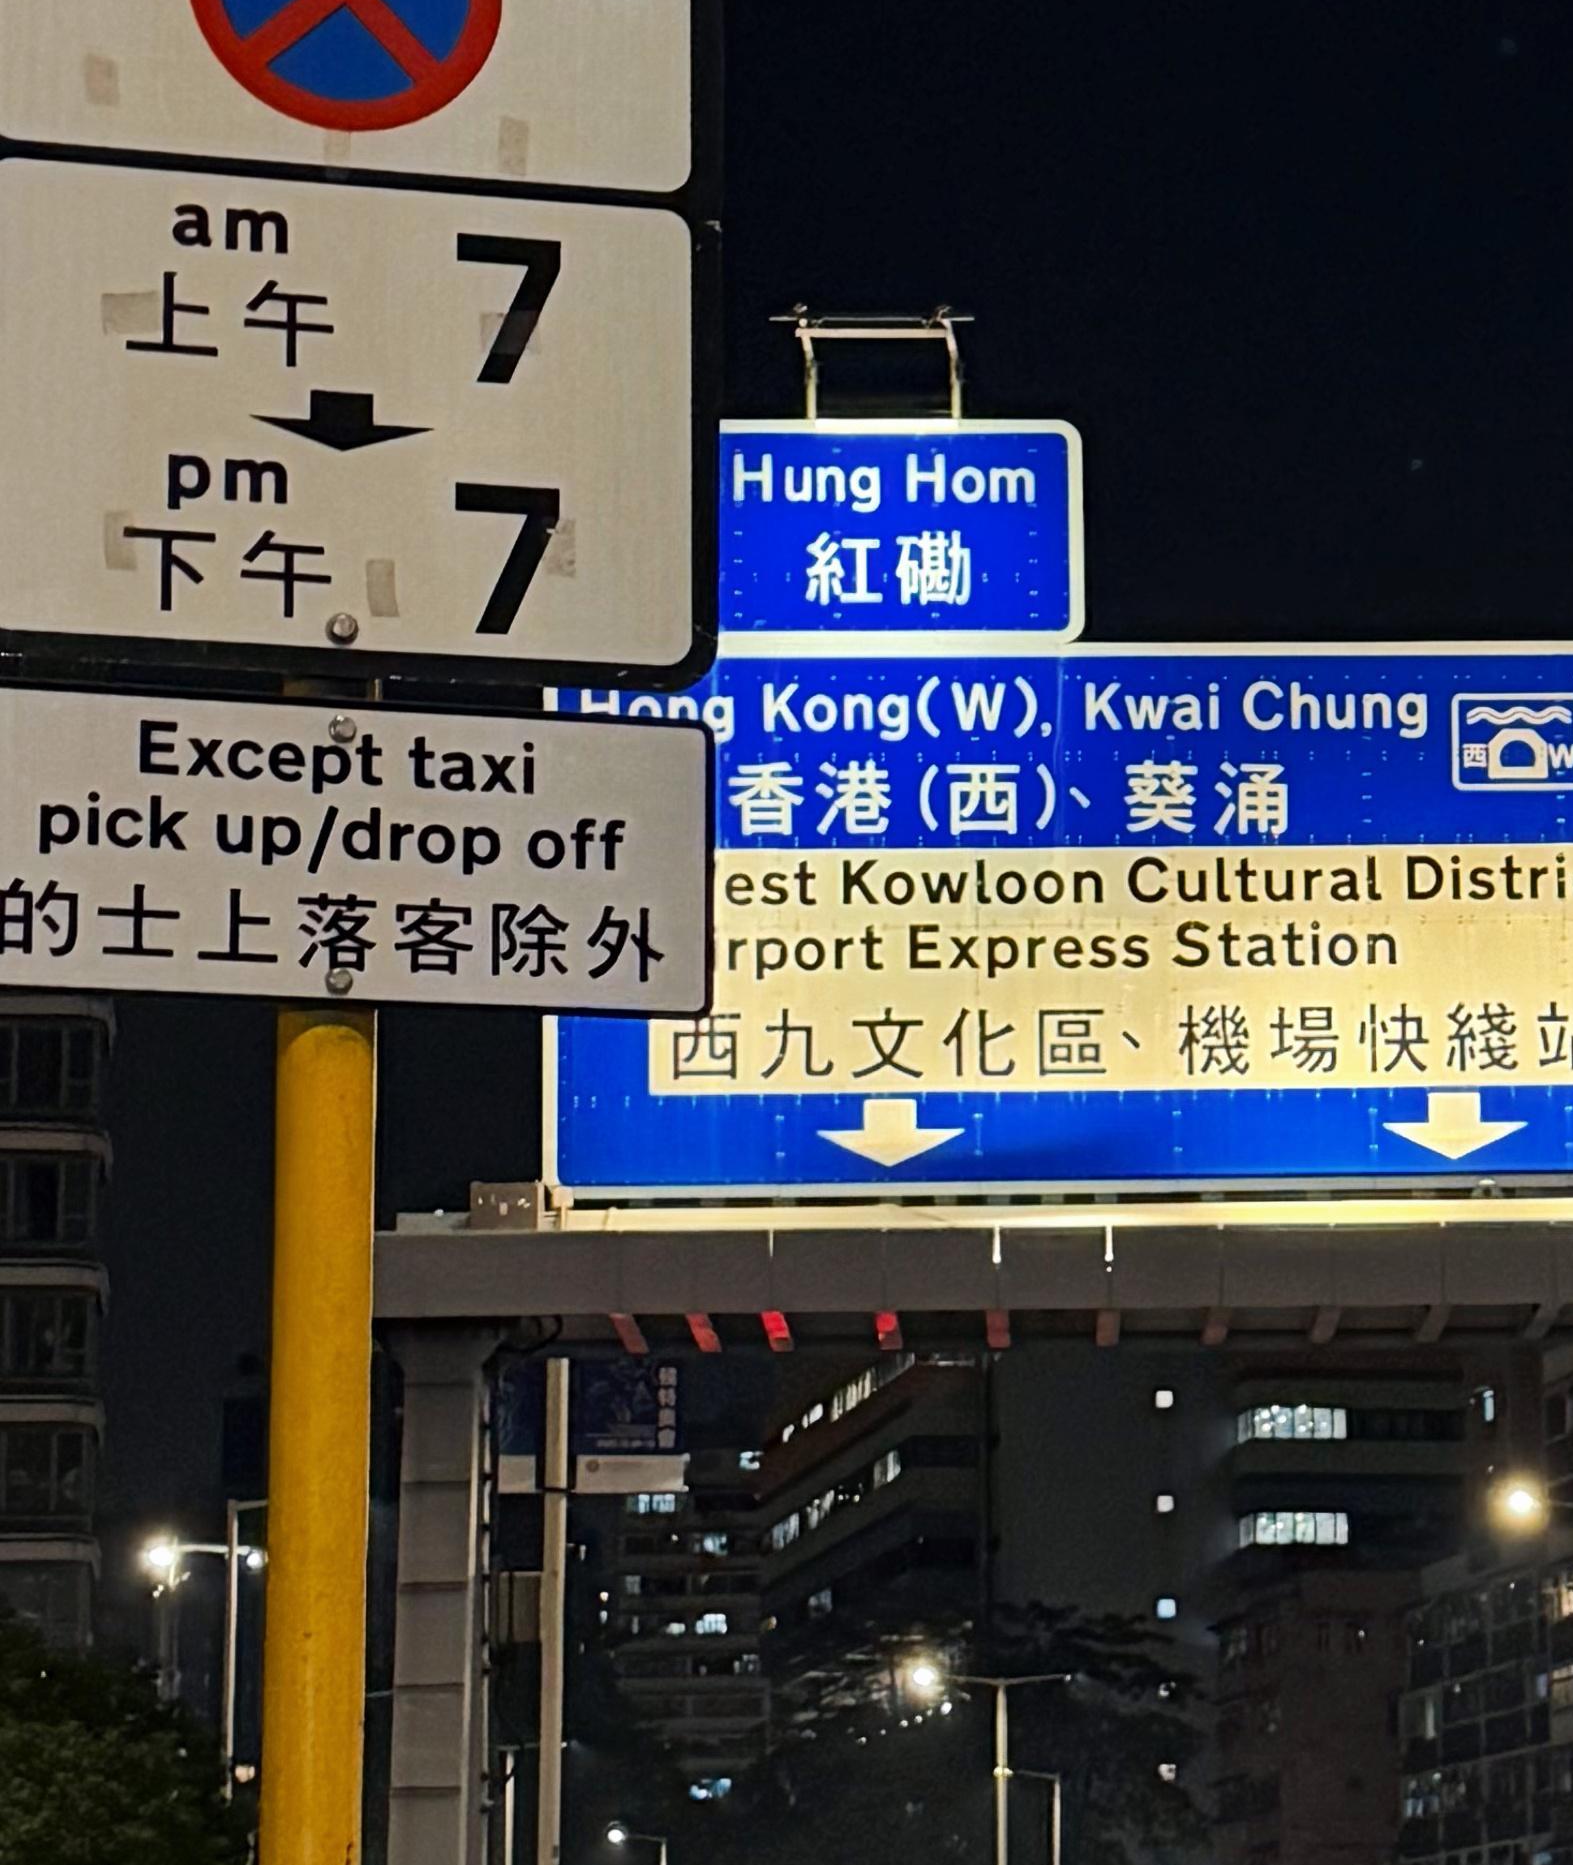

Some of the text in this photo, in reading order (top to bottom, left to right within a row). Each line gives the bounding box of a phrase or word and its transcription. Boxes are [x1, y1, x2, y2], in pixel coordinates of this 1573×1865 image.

[172, 204, 289, 254] am
[125, 271, 334, 368] 上午
[456, 232, 562, 384] 7
[167, 453, 288, 510] pm
[733, 453, 1035, 513] Hung Hom
[123, 526, 332, 618] 下午
[454, 482, 560, 635] 7
[805, 530, 971, 606] 紅磡
[1085, 682, 1219, 731] Kwai
[1242, 680, 1428, 739] Chung
[139, 718, 535, 795] Except taxi
[1462, 743, 1487, 768] 西
[39, 791, 626, 876] pick up/drop off
[725, 860, 817, 906] est
[841, 858, 1106, 906] Kowloon
[1127, 855, 1382, 903] Cultural
[0, 877, 665, 984] 的士上落客除外
[728, 921, 1397, 980] rport Express Station
